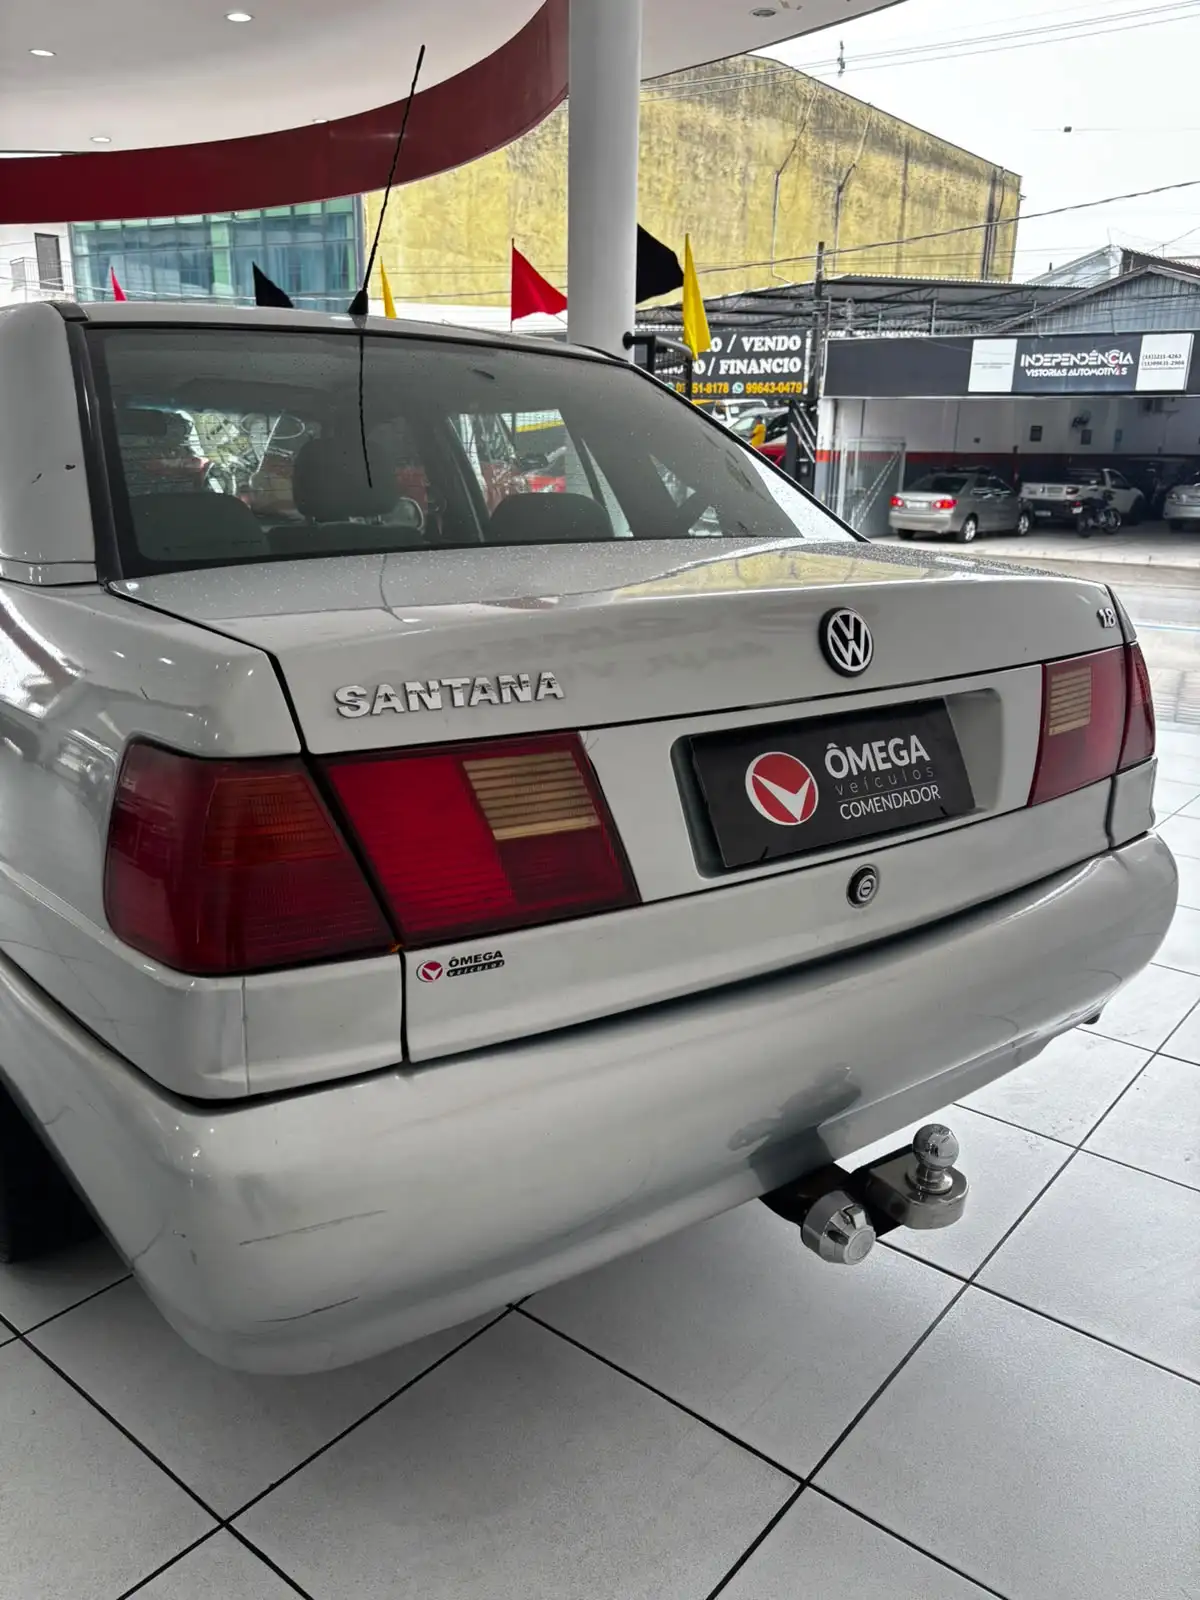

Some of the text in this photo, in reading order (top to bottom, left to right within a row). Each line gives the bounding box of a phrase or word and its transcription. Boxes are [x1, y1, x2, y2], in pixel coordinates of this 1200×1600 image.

[741, 335, 801, 352] VENDO
[718, 357, 801, 375] FINANCIO
[1020, 349, 1134, 367] INDEPENDÊNCIA
[1026, 368, 1066, 377] VISTORIAS
[745, 381, 802, 394] 99643-0479
[335, 671, 564, 718] SANTANA
[824, 734, 931, 779] ÔMEGA
[834, 766, 935, 796] veículos
[839, 784, 941, 820] COMENDADOR
[448, 950, 503, 968] ÔMEGA
